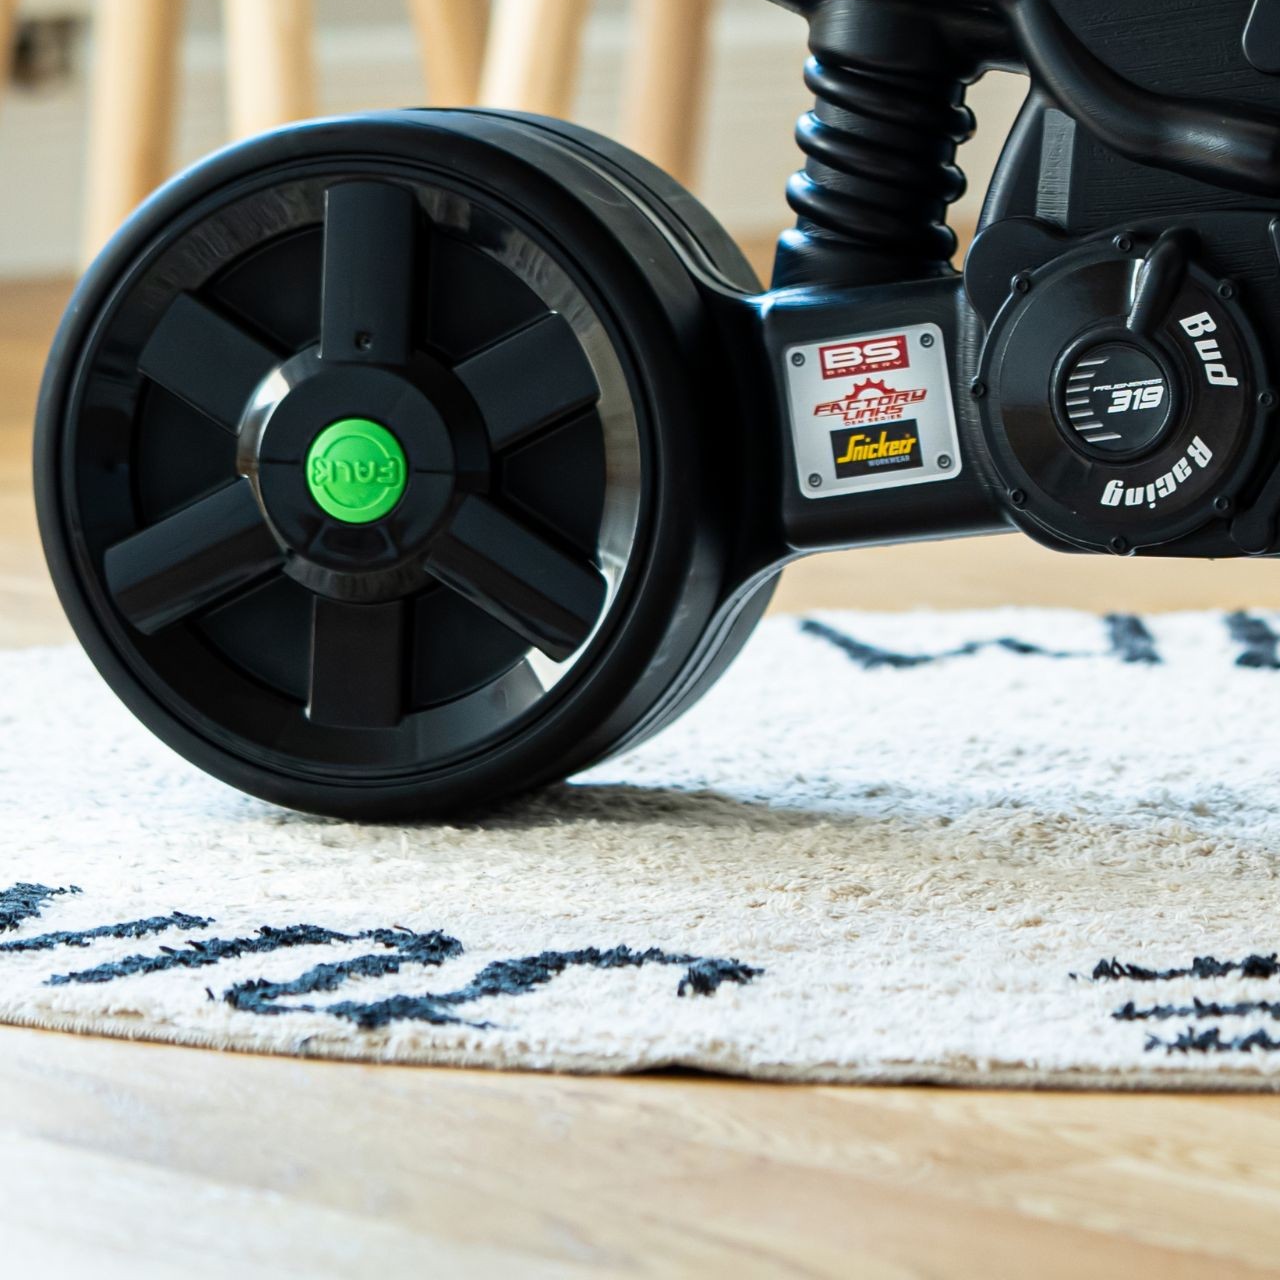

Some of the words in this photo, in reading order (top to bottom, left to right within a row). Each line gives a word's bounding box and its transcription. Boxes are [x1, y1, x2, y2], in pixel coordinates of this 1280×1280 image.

[824, 340, 901, 369] BS
[1178, 310, 1240, 388] Bud
[813, 388, 927, 417] FACTORY
[1107, 385, 1165, 414] 319
[1100, 434, 1214, 510] Racing
